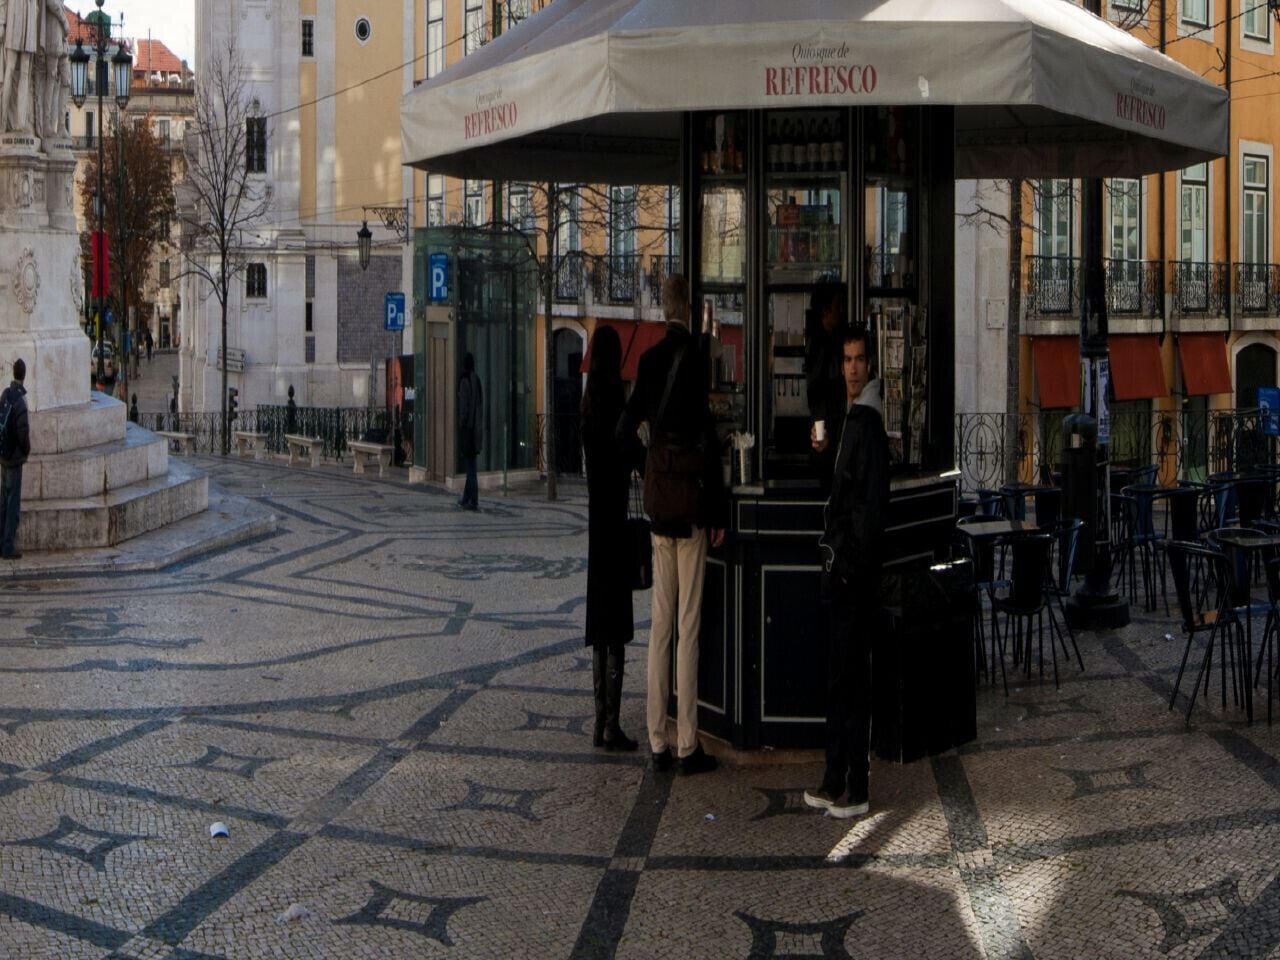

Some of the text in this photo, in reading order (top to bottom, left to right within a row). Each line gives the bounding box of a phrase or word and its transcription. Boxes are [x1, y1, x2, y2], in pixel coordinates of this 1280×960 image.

[792, 40, 850, 64] Quiosque de
[765, 64, 877, 96] REFRESCO
[464, 101, 517, 140] REFRESCO
[1115, 91, 1166, 130] REFRESCO
[432, 268, 445, 297] P
[387, 304, 397, 325] P
